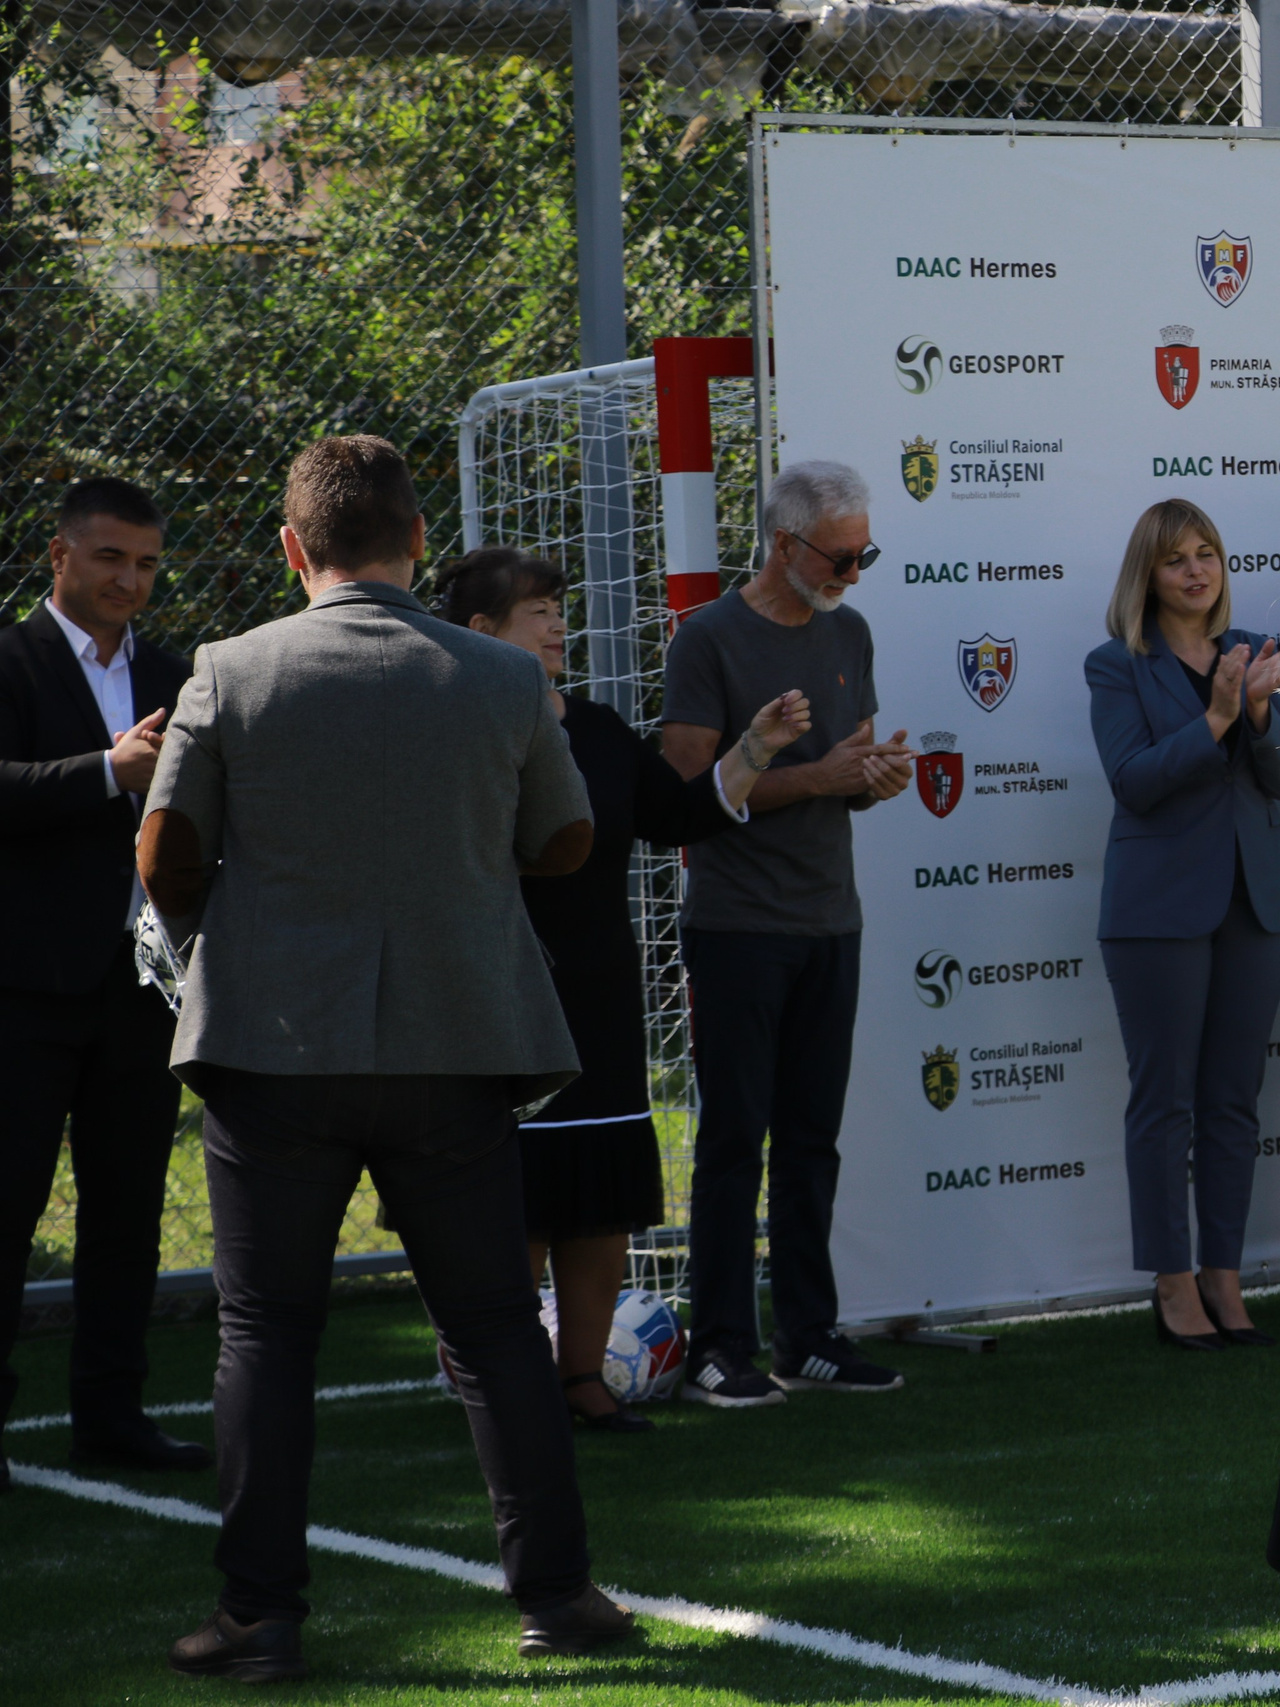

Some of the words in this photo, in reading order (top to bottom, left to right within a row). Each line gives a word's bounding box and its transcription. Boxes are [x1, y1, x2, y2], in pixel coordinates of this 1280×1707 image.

[1203, 248, 1246, 263] FMF
[896, 256, 962, 279] DAAC
[970, 257, 1057, 279] Hermes
[948, 354, 1065, 375] GEOSPORT
[1210, 358, 1273, 371] PRIMARIA
[1210, 380, 1235, 390] MUN.
[949, 439, 1009, 455] Consiliul
[1011, 438, 1063, 454] Raional
[1152, 455, 1214, 478] DAAC
[904, 561, 969, 585] DAAC
[977, 561, 1064, 582] Hermes
[966, 651, 1009, 666] FMF
[974, 761, 1041, 777] PRIMARIA
[974, 785, 1001, 796] MUN.
[914, 863, 980, 889] DAAC
[987, 862, 1075, 884] Hermes
[967, 957, 1084, 986] GEOSPORT
[969, 1042, 1029, 1062] Consiliul
[1031, 1037, 1083, 1056] Raional
[925, 1165, 991, 1193] DAAC
[999, 1160, 1086, 1185] Hermes
